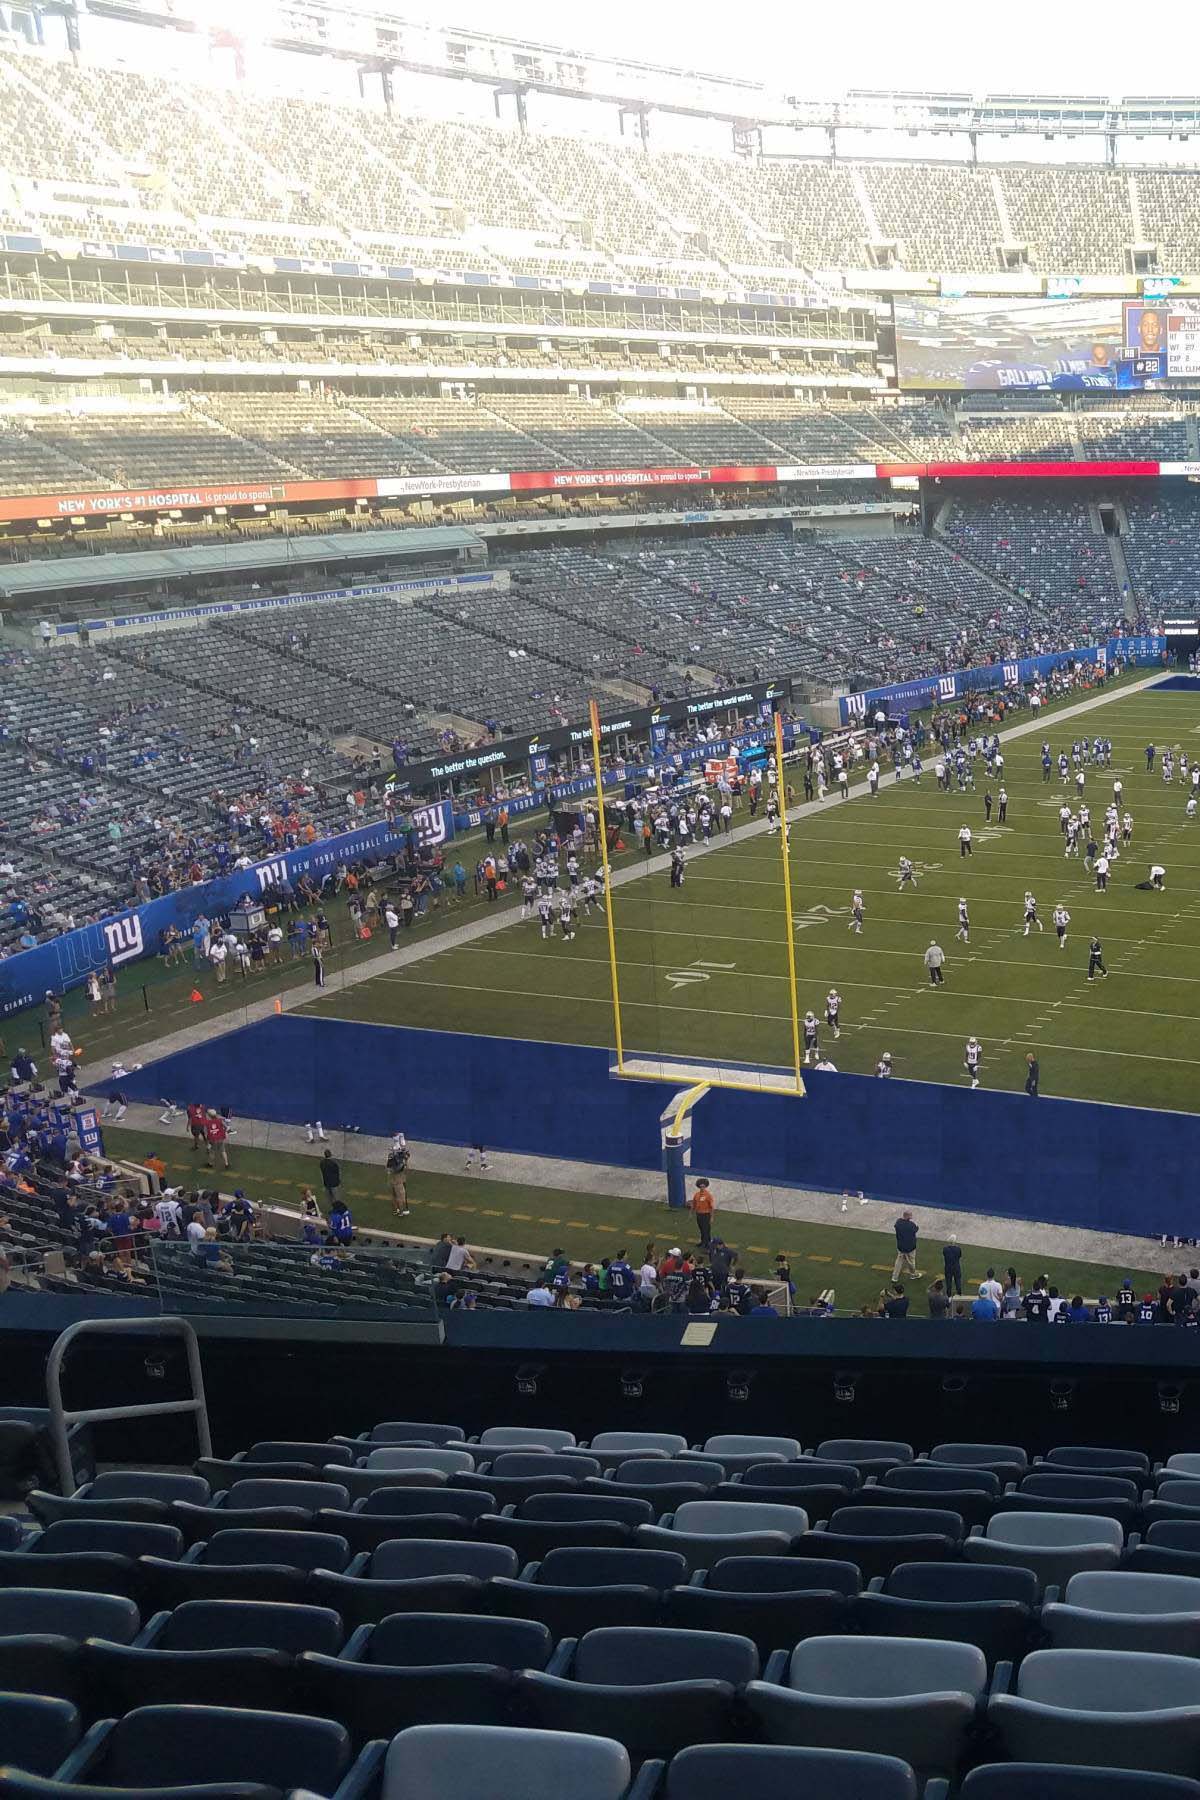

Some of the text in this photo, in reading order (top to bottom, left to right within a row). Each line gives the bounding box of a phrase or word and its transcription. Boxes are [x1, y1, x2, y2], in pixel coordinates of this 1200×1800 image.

[404, 478, 481, 493] NewYork-Presbyterian
[554, 475, 573, 485] NEW
[575, 474, 604, 484] YORK'S
[615, 473, 653, 483] HOSPITAL
[58, 490, 248, 513] NEW YORK'S #1 HOSPITAL is proud to
[1003, 664, 1018, 686] ny
[940, 677, 956, 700] ny
[687, 705, 697, 713] The
[698, 702, 714, 712] better
[714, 699, 723, 708] the
[738, 693, 754, 703] works.
[845, 693, 866, 719] ny
[652, 715, 659, 724] EY
[570, 731, 582, 741] The
[601, 724, 611, 734] the
[611, 720, 632, 732] answer.
[529, 744, 538, 754] EY
[708, 744, 725, 755] YORK
[431, 751, 507, 778] The better the question.
[514, 775, 607, 811] YORK FTBALL GIANS
[413, 805, 446, 847] ny
[469, 812, 481, 827] ny
[292, 838, 381, 874] NEW YORK FOOTBALL
[104, 914, 144, 965] ny
[665, 960, 736, 989] 10
[84, 1131, 98, 1144] ny
[161, 1209, 173, 1223] 12
[341, 1215, 350, 1230] 11
[611, 1273, 624, 1287] 10
[730, 1293, 741, 1305] 12
[1120, 1294, 1132, 1304] 13
[1032, 1304, 1039, 1314] 4
[1140, 1310, 1153, 1320] 10
[1098, 1313, 1108, 1323] 13
